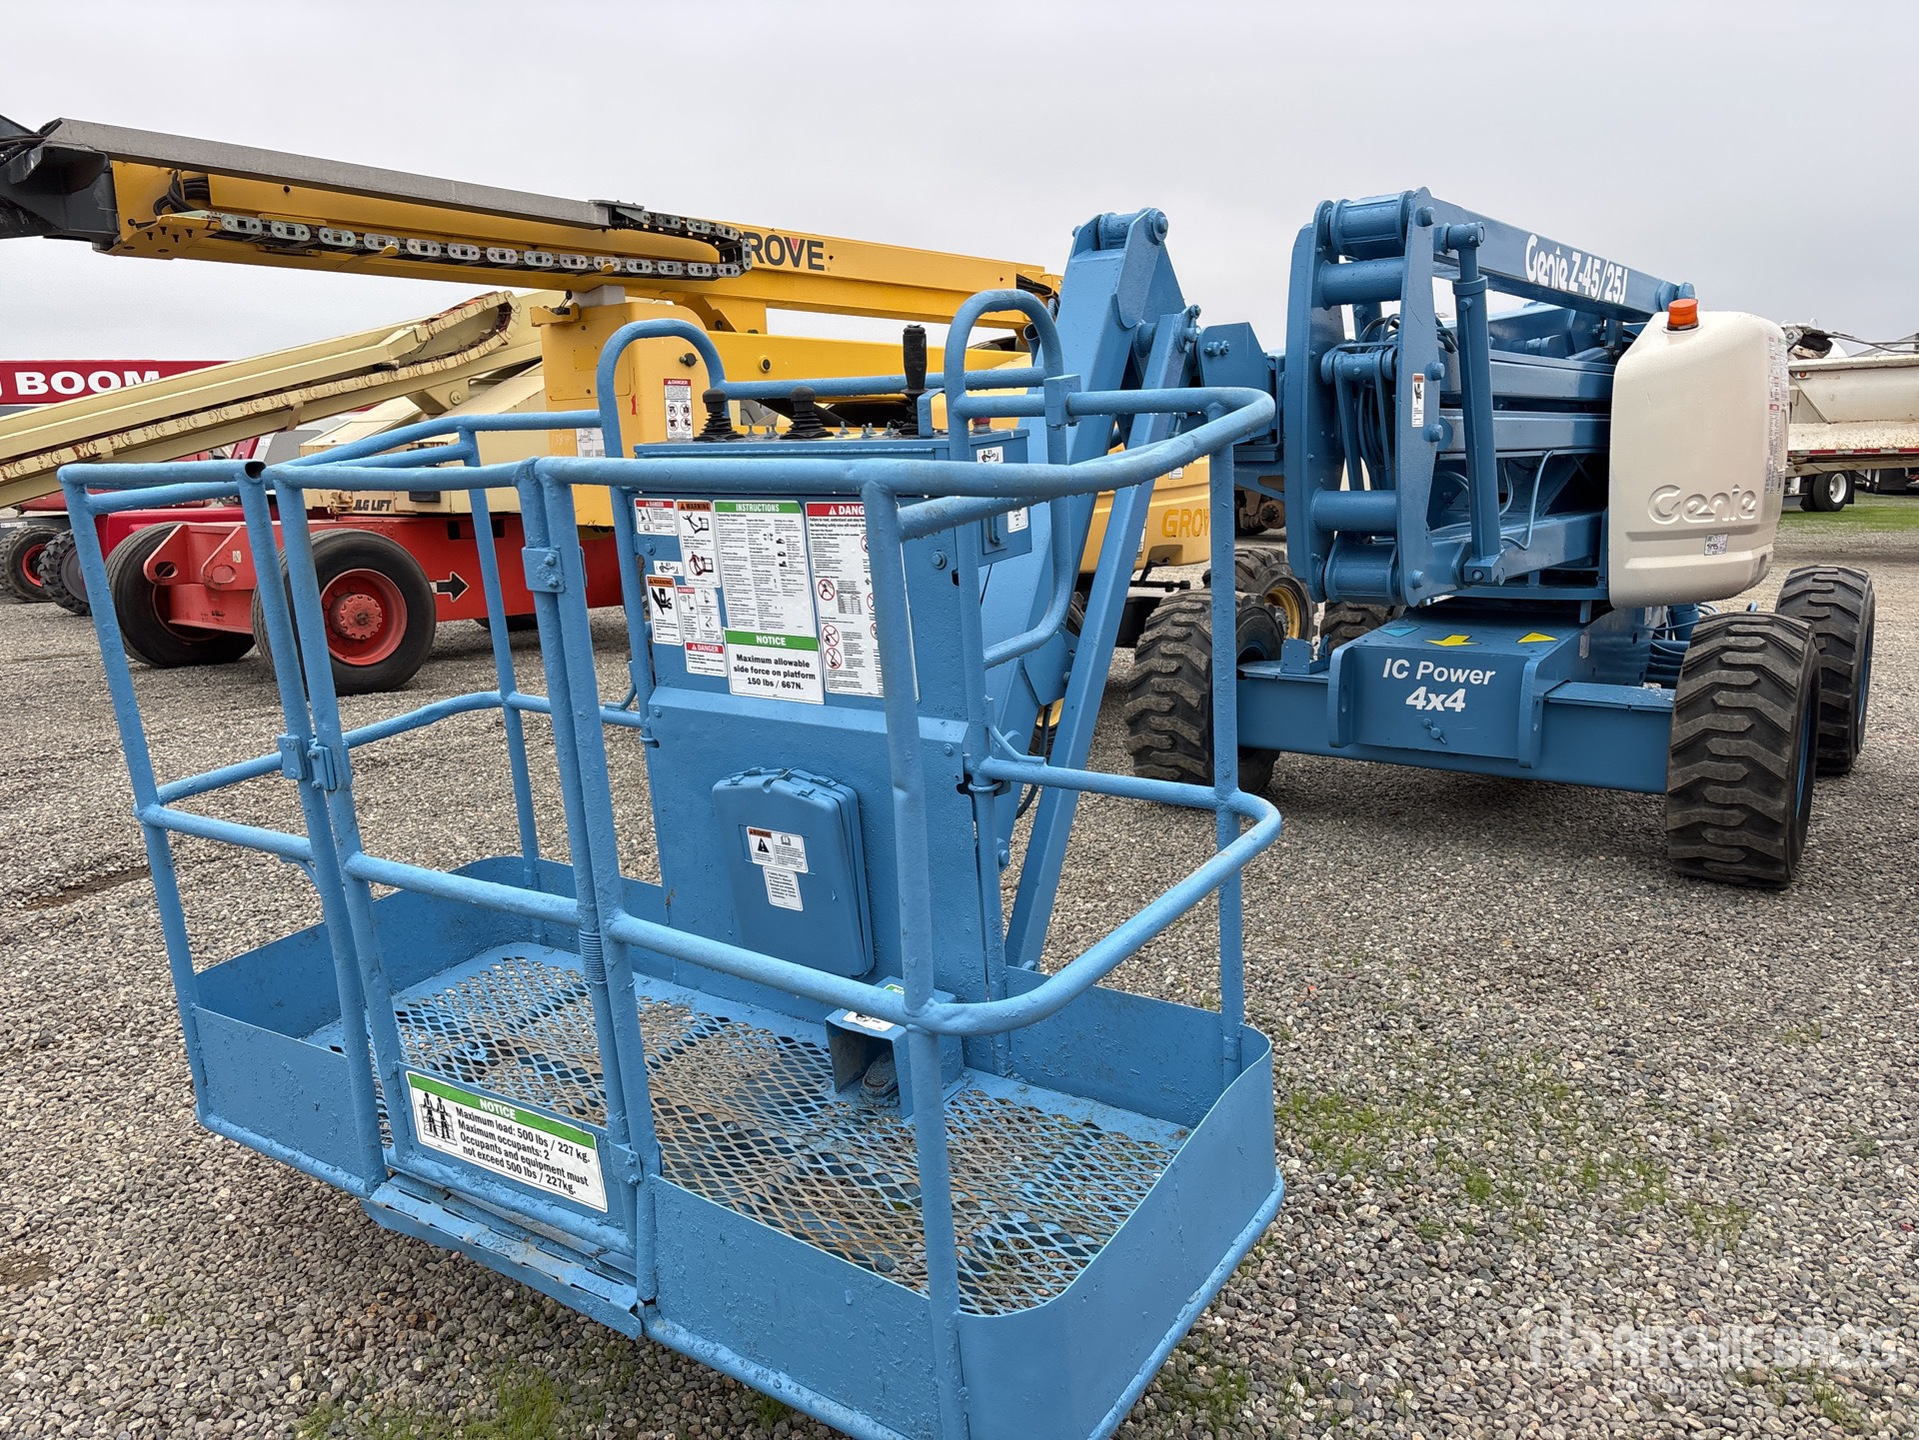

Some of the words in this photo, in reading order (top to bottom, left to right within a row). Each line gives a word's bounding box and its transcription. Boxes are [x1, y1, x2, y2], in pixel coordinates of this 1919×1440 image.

[743, 231, 825, 271] ROVE
[1525, 234, 1568, 292] Genie
[1568, 251, 1628, 305] Z-45/25J
[353, 499, 370, 511] JLG
[371, 499, 392, 511] LIFT
[735, 503, 780, 512] INSTRUCTIONS
[838, 505, 865, 515] DANG
[1647, 484, 1757, 525] Genie
[1161, 509, 1209, 538] GROV
[697, 644, 719, 653] DANGER
[756, 635, 786, 646] NOTICE
[733, 665, 749, 673] side
[750, 666, 770, 676] force
[783, 670, 816, 680] platform
[736, 653, 772, 664] Maximum
[774, 657, 810, 668] allowable
[1382, 657, 1410, 679] IC
[1416, 661, 1496, 685] Power
[747, 677, 761, 685] 150
[763, 678, 774, 687] lbs
[781, 681, 804, 690] 667N.
[1405, 686, 1466, 712] 4x4
[479, 1099, 516, 1120] NOTICE
[456, 1106, 494, 1129] Maximum
[495, 1119, 516, 1136] load:
[517, 1128, 534, 1143] 500
[535, 1134, 549, 1148] lbs
[557, 1142, 574, 1157] 227
[576, 1148, 591, 1164] kg.
[458, 1119, 496, 1141] Maximum
[497, 1135, 543, 1158] occupants:
[544, 1150, 550, 1160] 2
[460, 1131, 502, 1156] Occupants
[504, 1147, 519, 1162] and
[520, 1154, 565, 1176] equipment
[566, 1171, 589, 1186] must
[462, 1146, 476, 1158] not
[477, 1152, 505, 1168] exceed
[505, 1160, 522, 1174] 500
[523, 1167, 537, 1181] lbs
[545, 1174, 576, 1195] 227kg.
